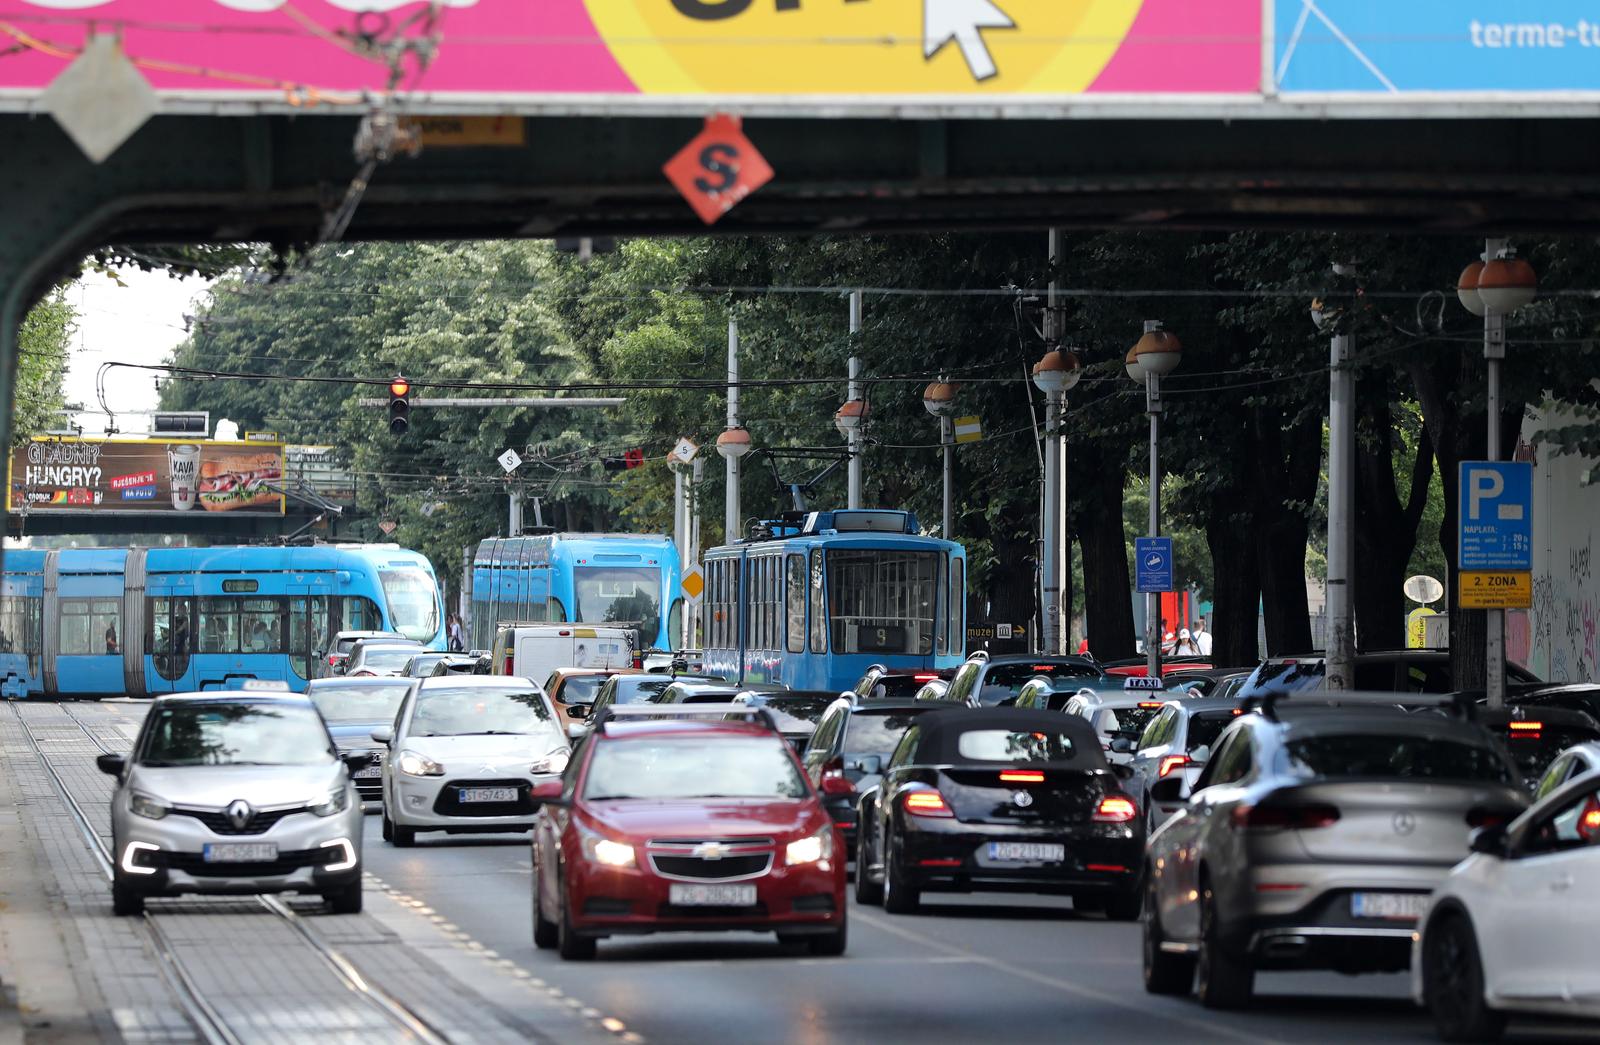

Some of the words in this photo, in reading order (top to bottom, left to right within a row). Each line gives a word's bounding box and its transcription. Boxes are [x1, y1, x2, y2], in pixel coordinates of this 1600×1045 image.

[694, 144, 740, 193] S
[174, 460, 194, 474] KAVA
[506, 456, 514, 466] S
[26, 466, 102, 487] HUNGRY?
[1469, 469, 1504, 520] P
[1513, 534, 1523, 543] 20
[1513, 542, 1522, 551] 15
[1487, 576, 1518, 587] ZONA
[876, 629, 886, 647] 9
[967, 626, 994, 640] muzej
[1131, 679, 1158, 688] TAXI
